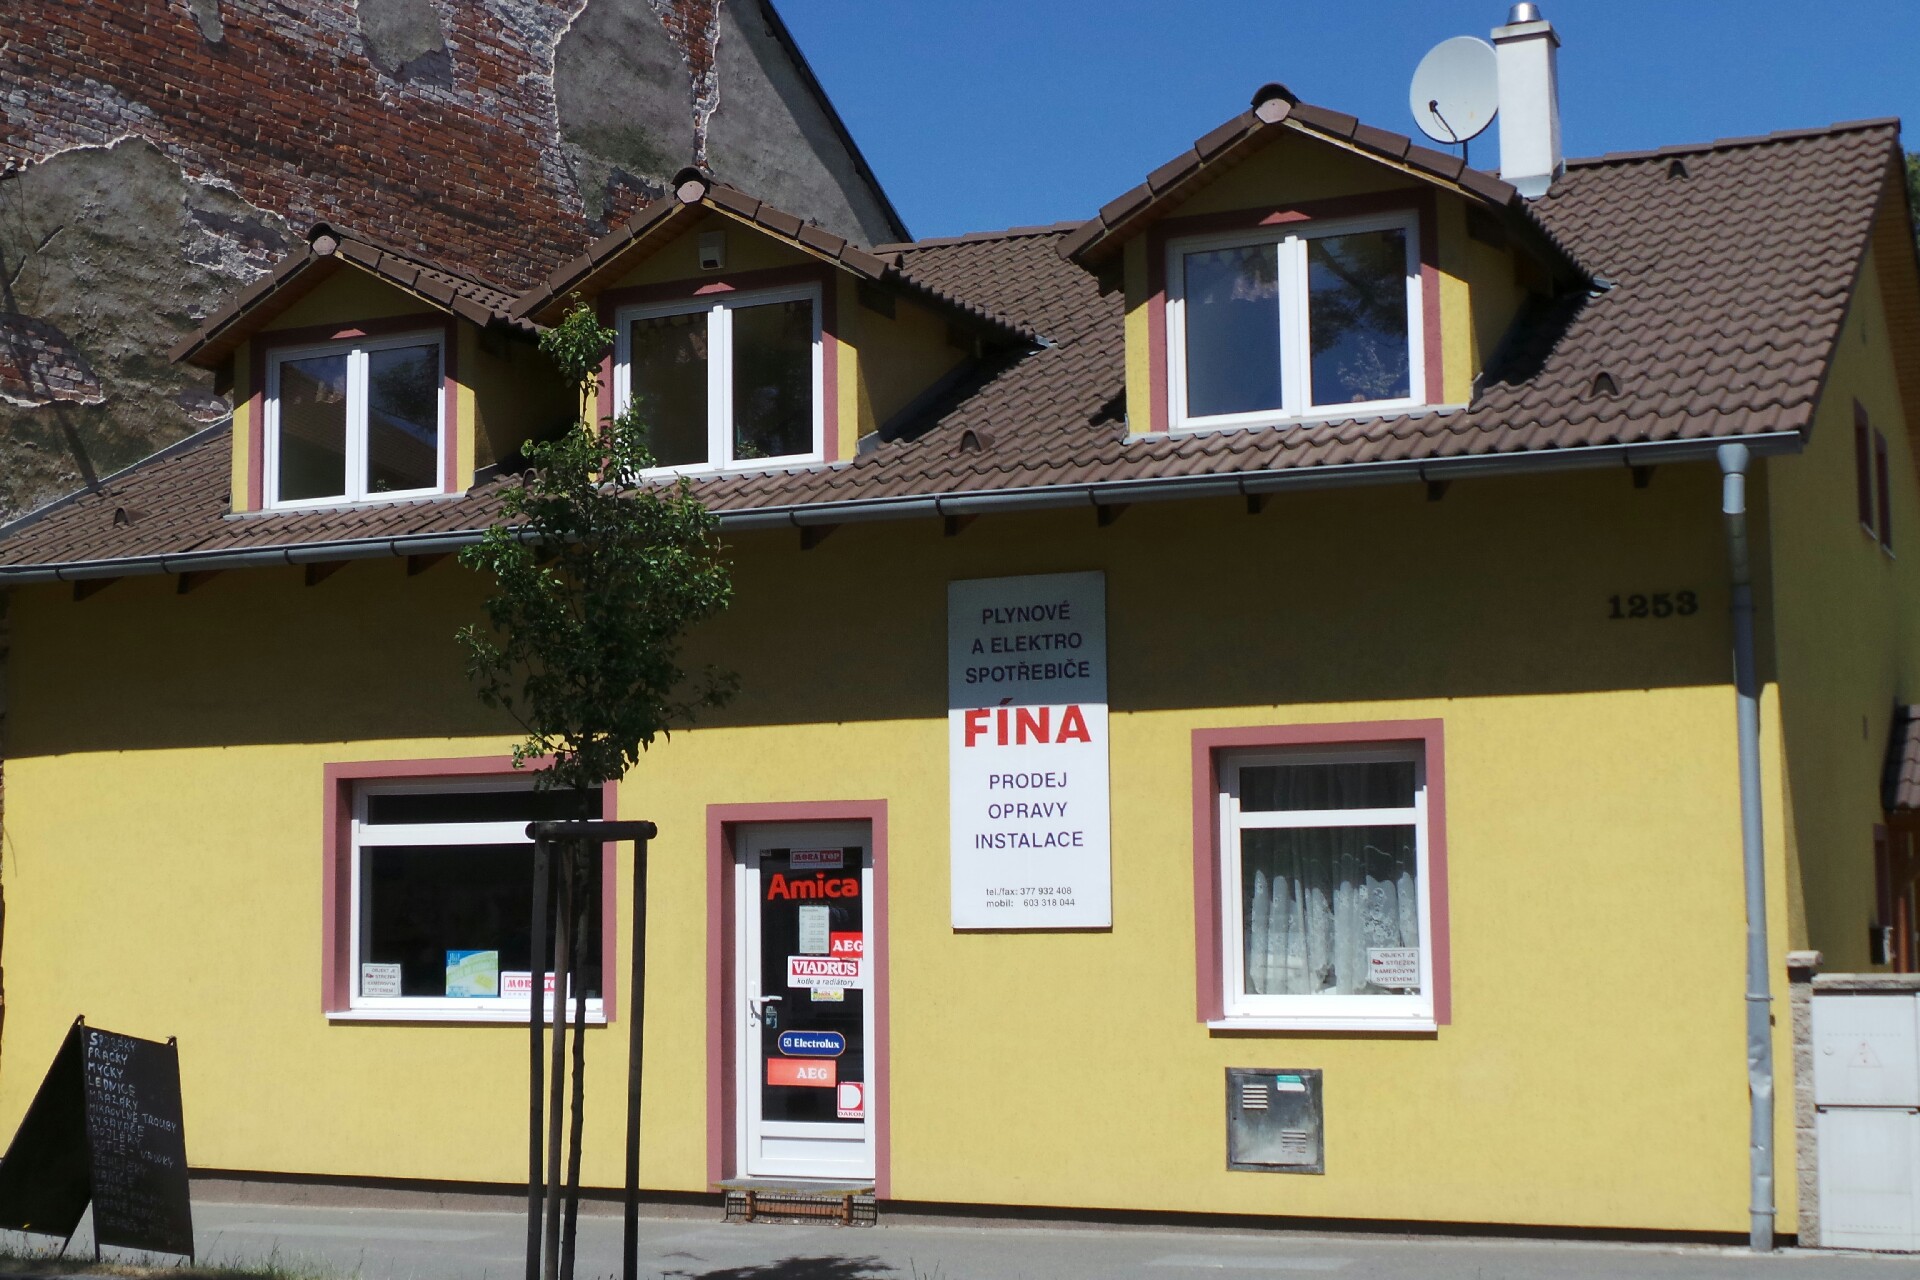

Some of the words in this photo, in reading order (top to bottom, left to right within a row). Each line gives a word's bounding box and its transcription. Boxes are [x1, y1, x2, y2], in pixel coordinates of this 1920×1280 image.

[982, 600, 1071, 625] PLYNOVÉ
[1608, 590, 1698, 619] 1253
[971, 639, 984, 655] A
[991, 632, 1083, 654] ELEKTRO
[965, 658, 1090, 684] SPOTŘEBIČE
[964, 697, 1092, 748] FÍNA
[989, 771, 1068, 790] PRODEJ
[988, 801, 1068, 819] OPRAVY
[975, 831, 1084, 849] INSTALACE
[767, 871, 859, 900] Amica
[986, 887, 1018, 896] tel./fax:
[1020, 888, 1036, 896] 377
[1038, 887, 1054, 896] 932
[1056, 887, 1072, 895] 408
[986, 899, 1014, 908] mobil:
[1023, 899, 1039, 907] 603
[1041, 899, 1057, 907] 318
[1059, 899, 1075, 907] 044
[832, 940, 863, 952] AEG
[792, 960, 857, 976] VIADRUS
[822, 979, 855, 987] radiátory
[793, 1038, 840, 1049] Electrolux
[796, 1067, 828, 1079] AEG
[88, 1075, 136, 1098] LEDNICE
[141, 1113, 177, 1134] TROUBY
